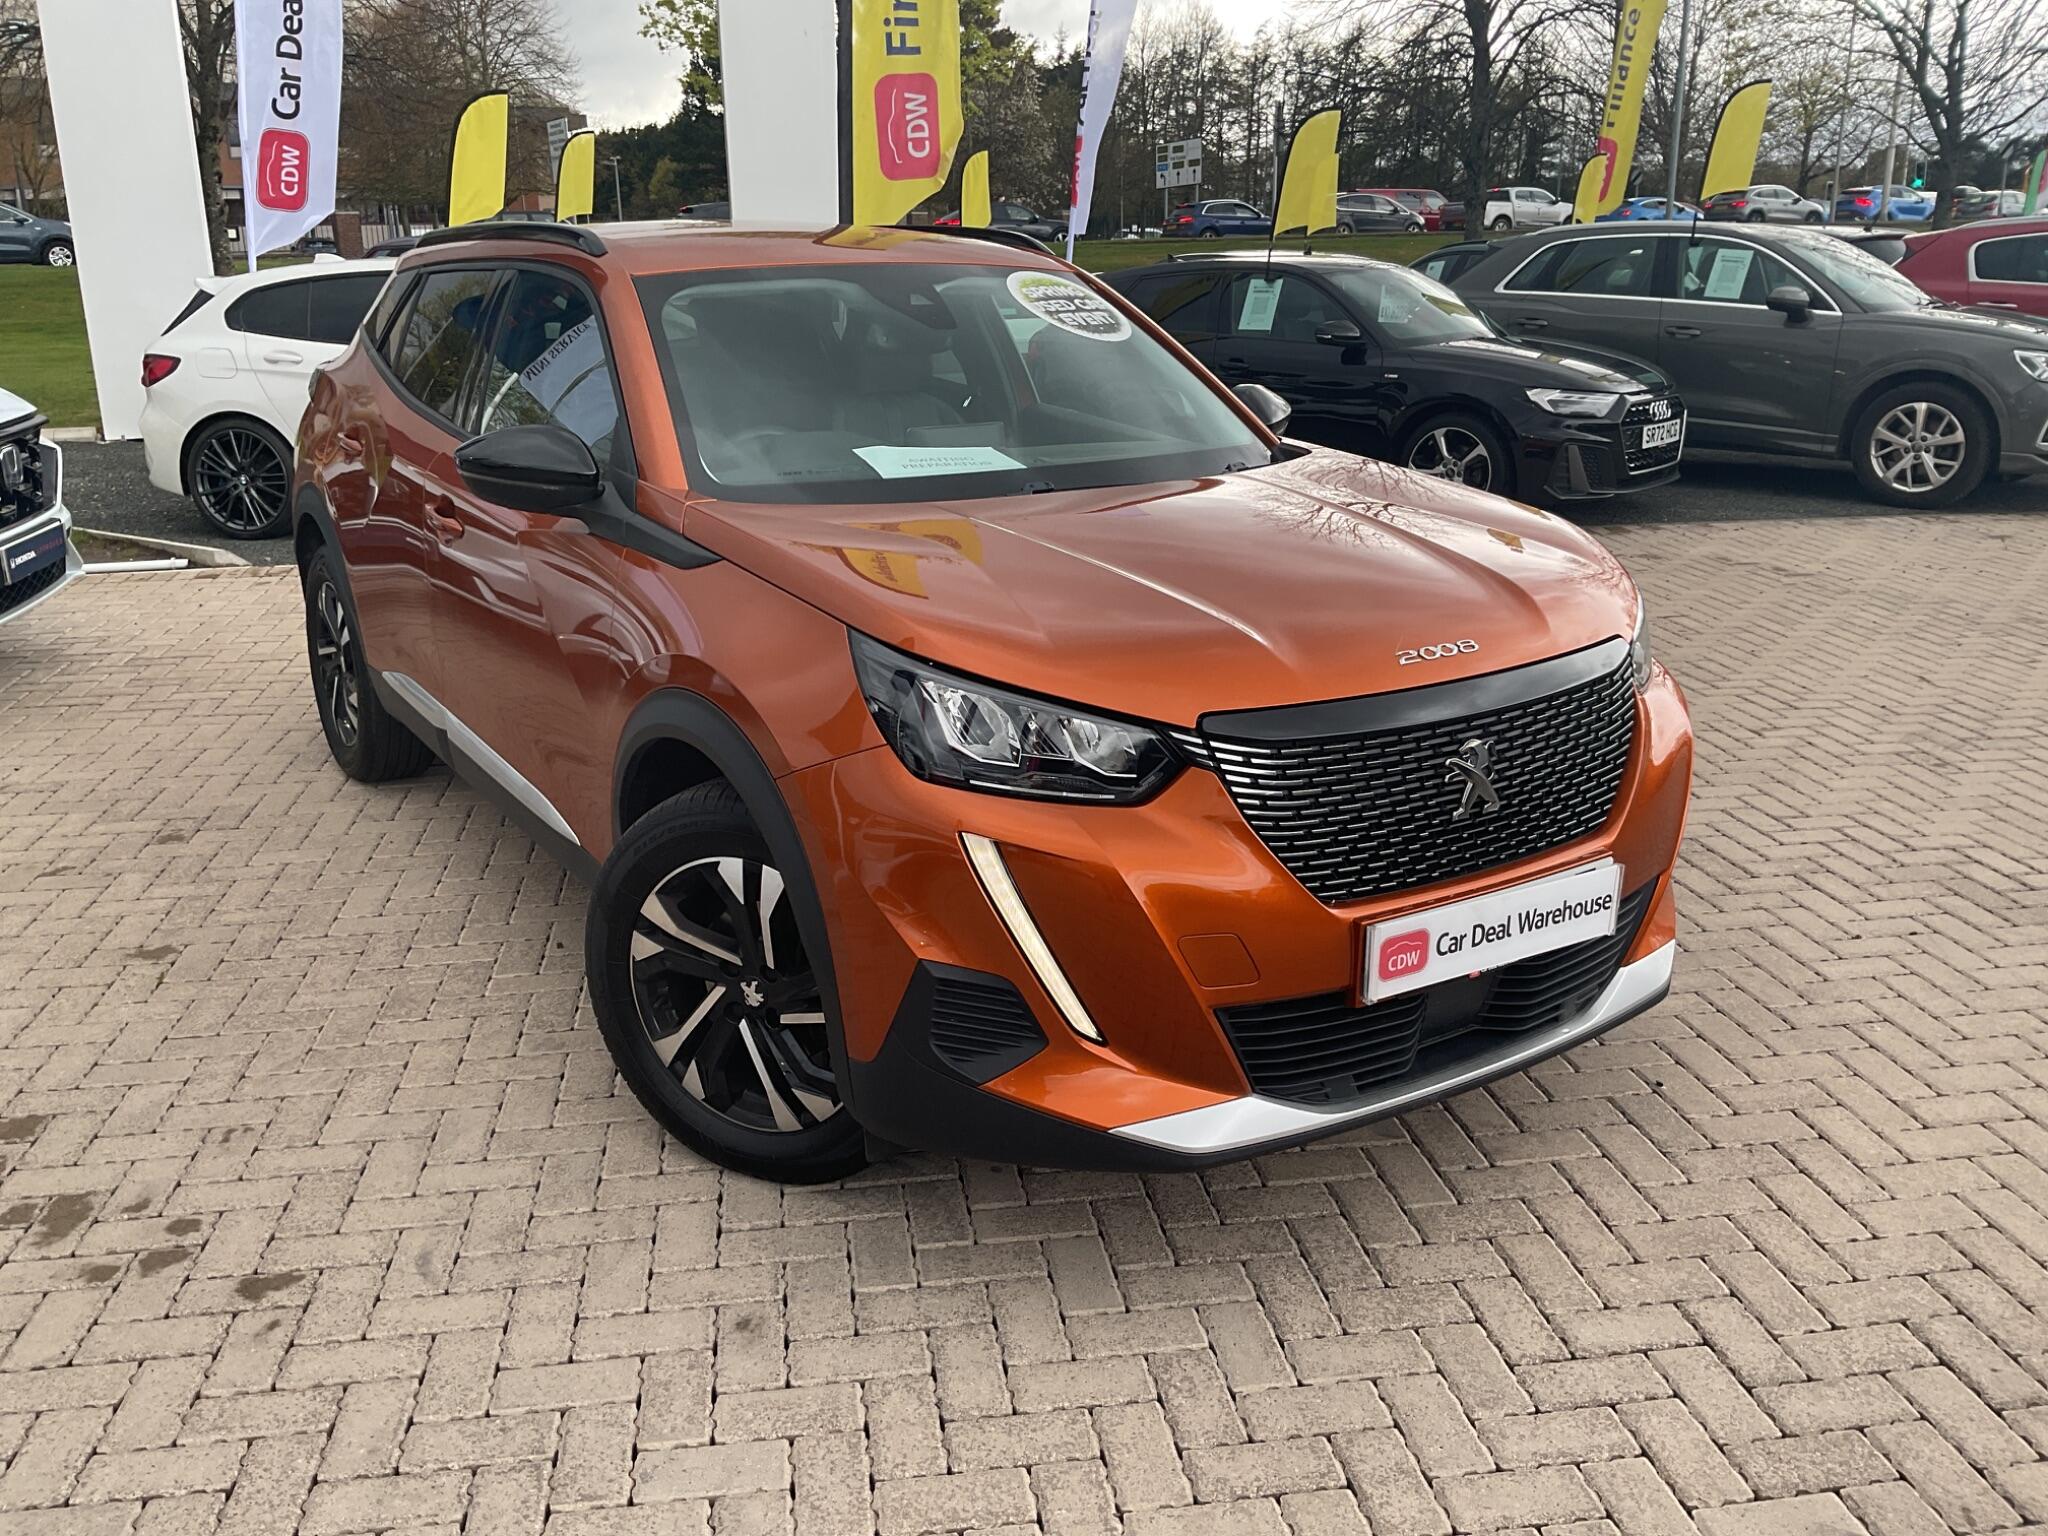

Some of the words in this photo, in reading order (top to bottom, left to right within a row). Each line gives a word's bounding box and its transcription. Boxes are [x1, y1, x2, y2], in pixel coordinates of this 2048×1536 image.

[271, 67, 301, 120] Car
[903, 92, 931, 158] CDW
[280, 145, 301, 196] CDW
[1057, 310, 1116, 326] EVENT
[1646, 425, 1665, 443] SR72
[1395, 639, 1479, 665] 2008
[1388, 950, 1420, 971] CDW
[1436, 932, 1467, 957] Car
[1471, 915, 1512, 948] Deal
[1518, 894, 1612, 934] Warehouse
